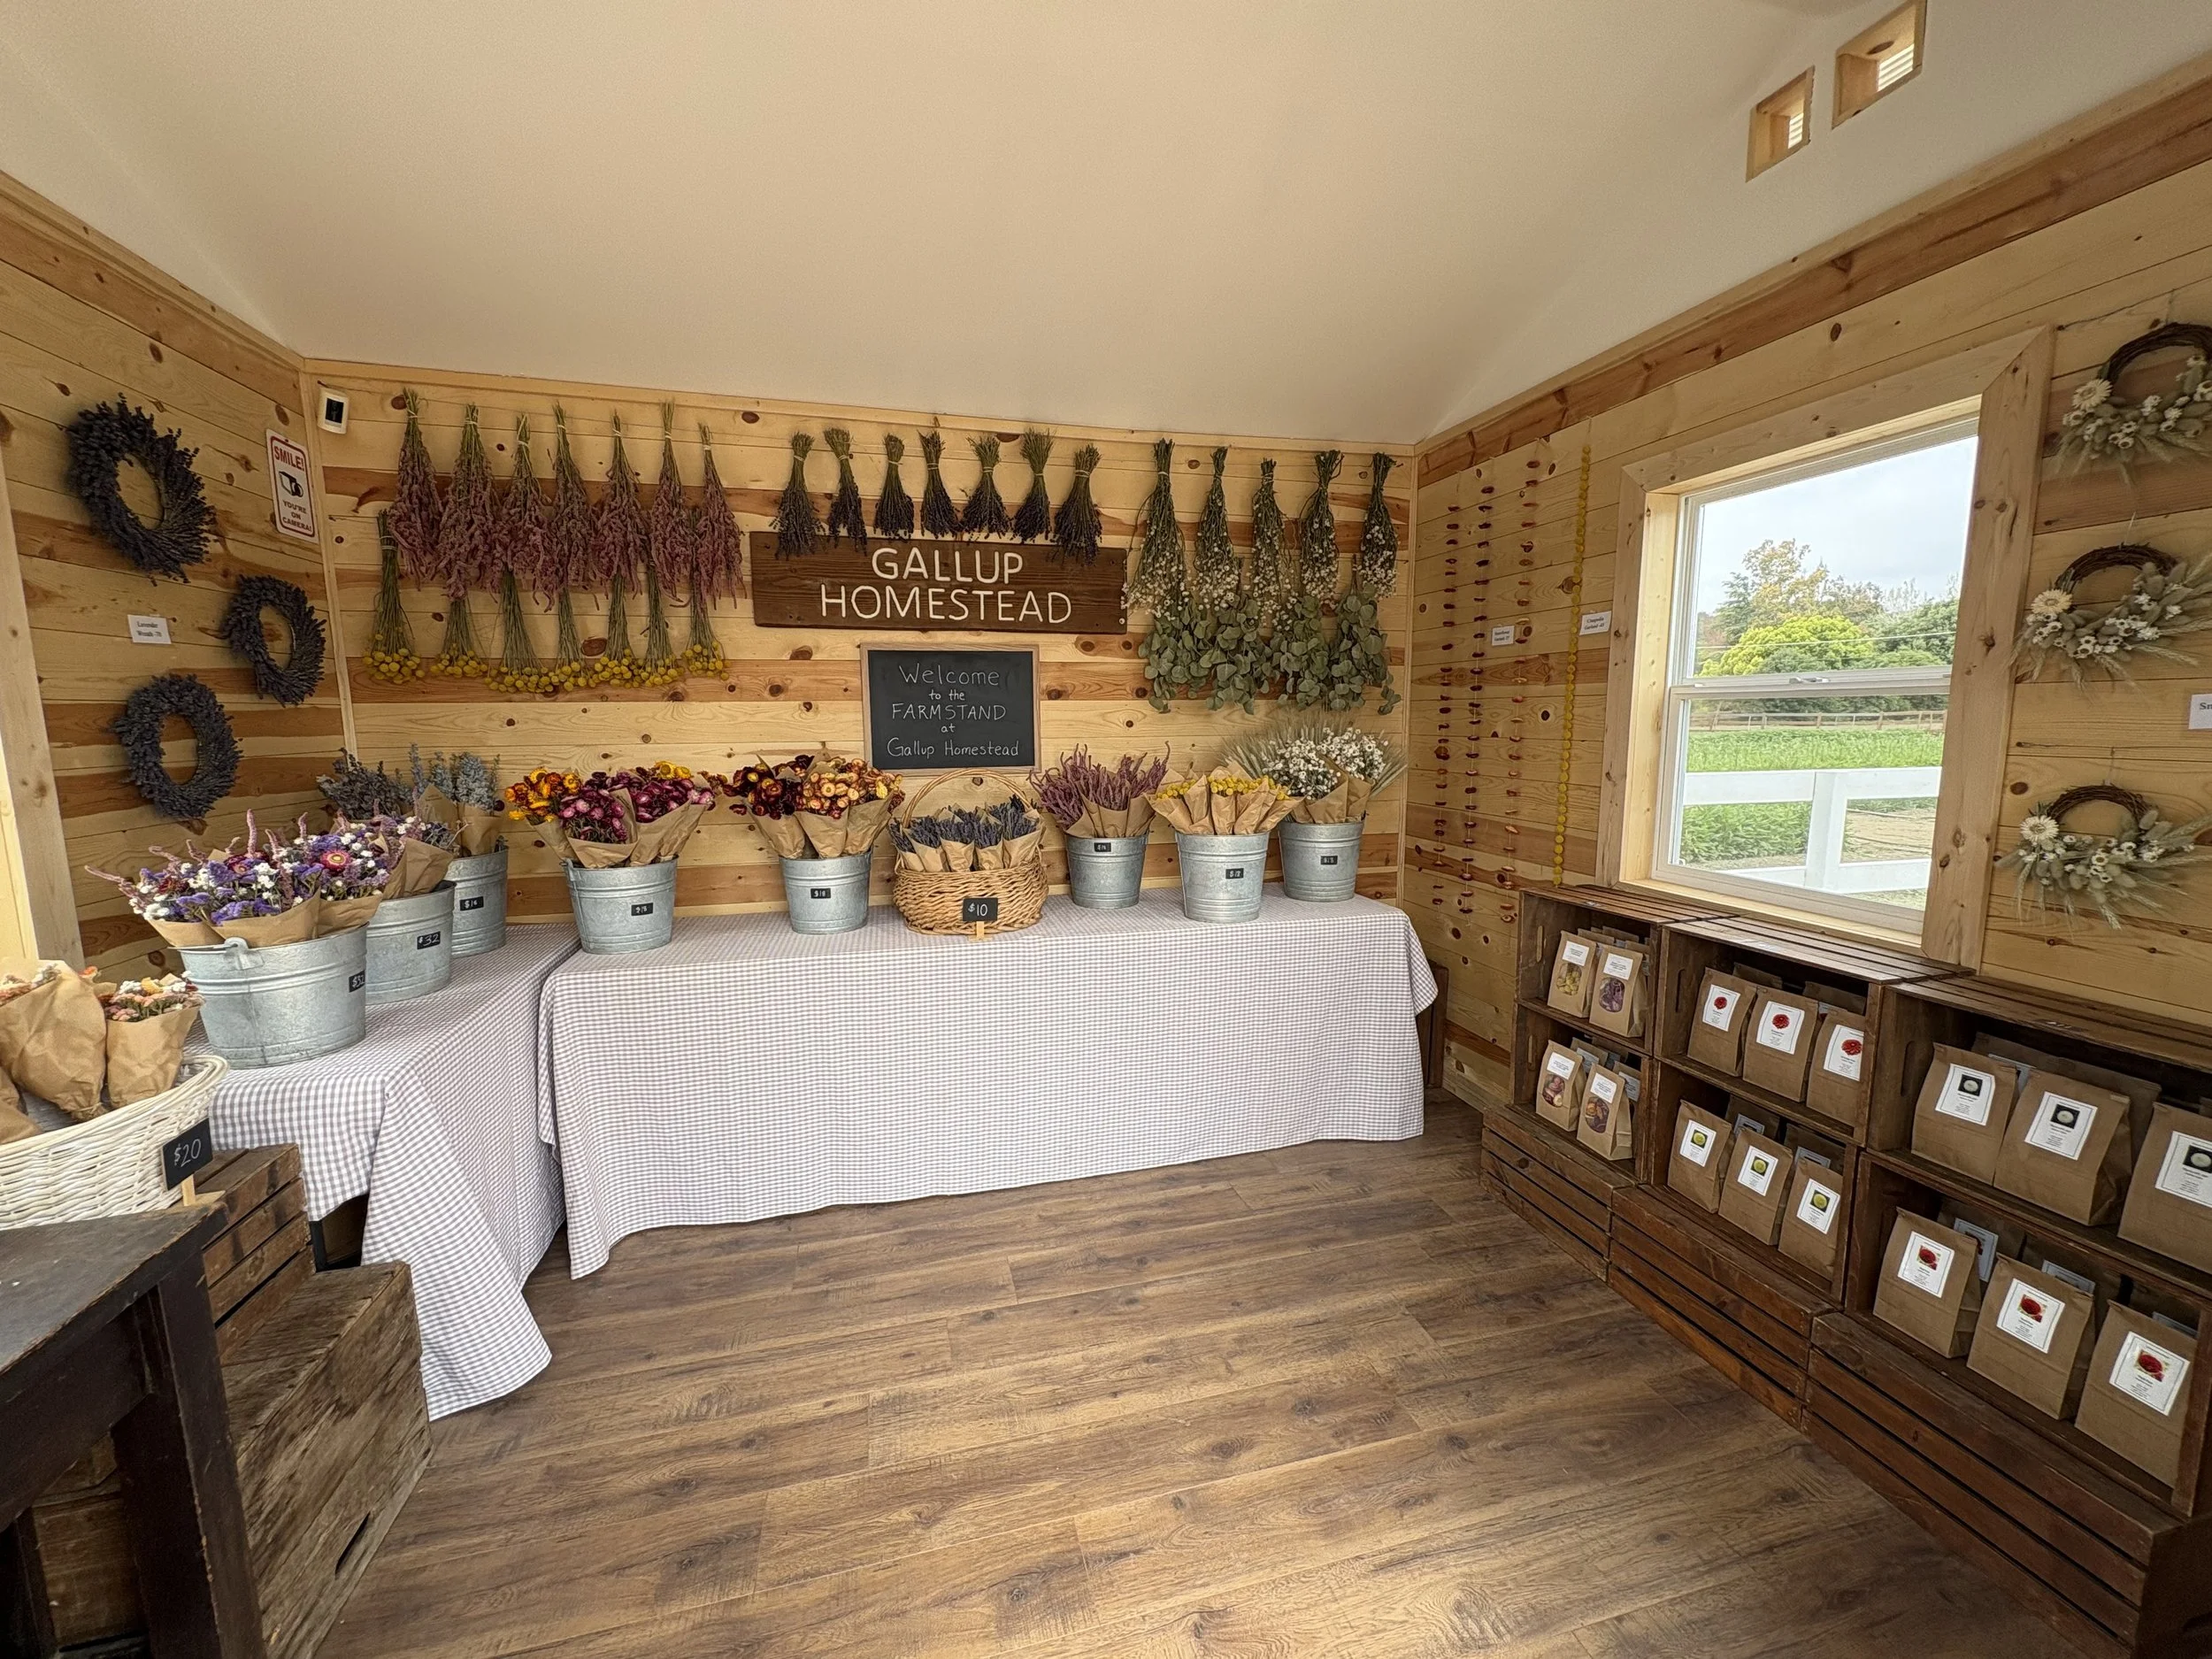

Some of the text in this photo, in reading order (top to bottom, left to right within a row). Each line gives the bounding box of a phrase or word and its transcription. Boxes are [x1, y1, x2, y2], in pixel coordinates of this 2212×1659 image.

[274, 446, 304, 472] SMILE!
[283, 500, 307, 514] YOU'RE
[291, 511, 301, 520] ON
[282, 516, 311, 532] CAMERA!
[872, 547, 1023, 584] GALLUP
[820, 584, 1071, 624] HOMESTEAD
[899, 663, 1000, 686] Welcome
[929, 689, 965, 701] to the
[892, 703, 1006, 720] FARMSTAND
[941, 723, 956, 733] at
[887, 737, 1019, 759] Gallup Homestead
[968, 902, 988, 917] $10
[418, 933, 440, 947] $32
[174, 1139, 201, 1167] $20
